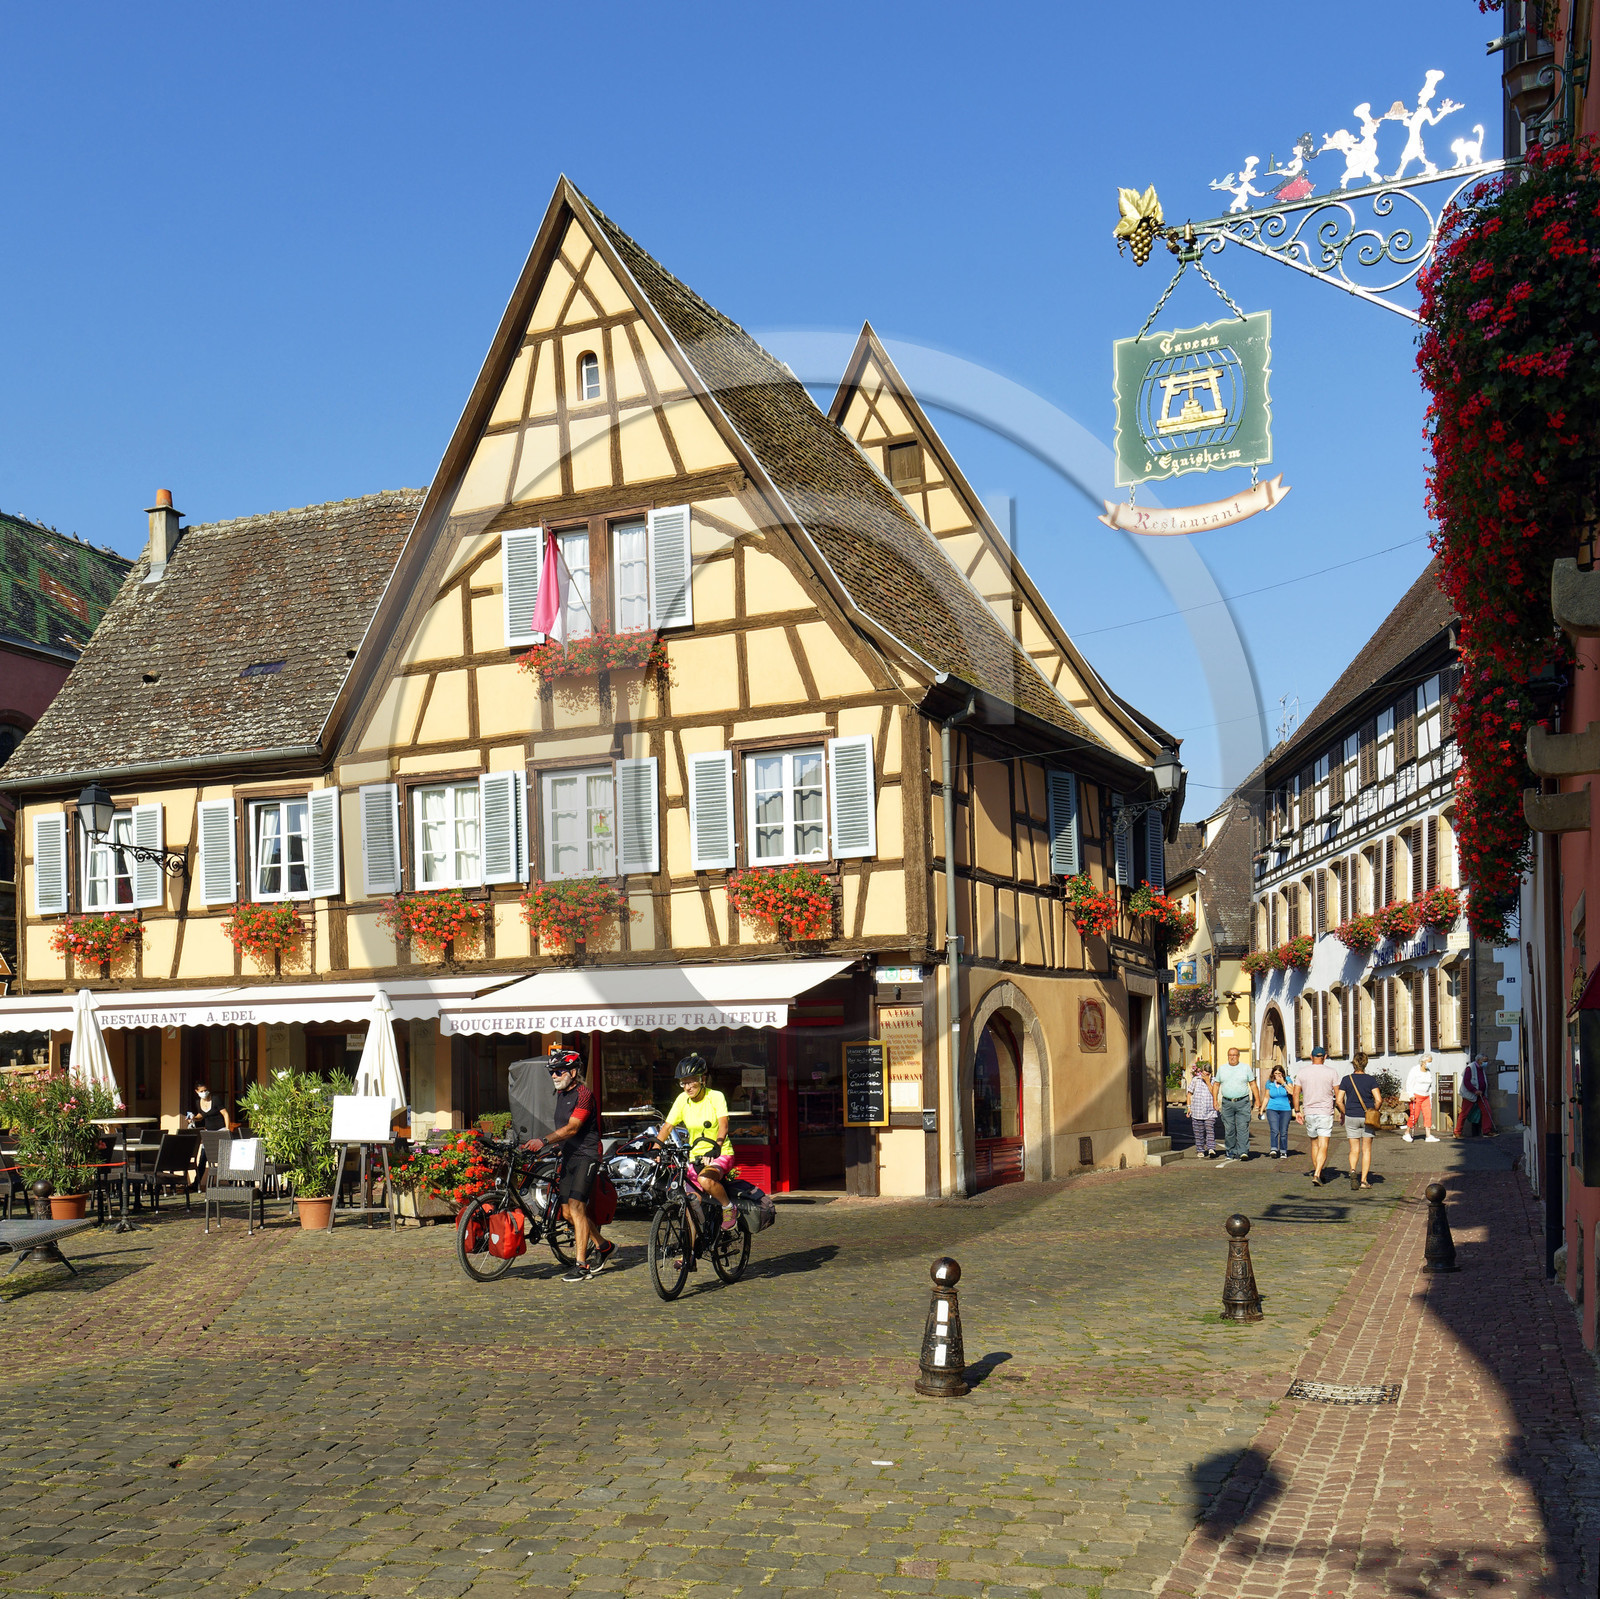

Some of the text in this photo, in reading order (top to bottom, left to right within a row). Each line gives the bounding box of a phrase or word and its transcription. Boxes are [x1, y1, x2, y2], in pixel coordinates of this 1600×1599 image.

[1159, 335, 1220, 356] Caveau
[1133, 502, 1243, 534] Restaurant
[101, 1010, 256, 1025] RESTAURANT A. EDEL
[450, 1011, 778, 1031] BOUCHERIE CHARCUTERIE TRAITEUR
